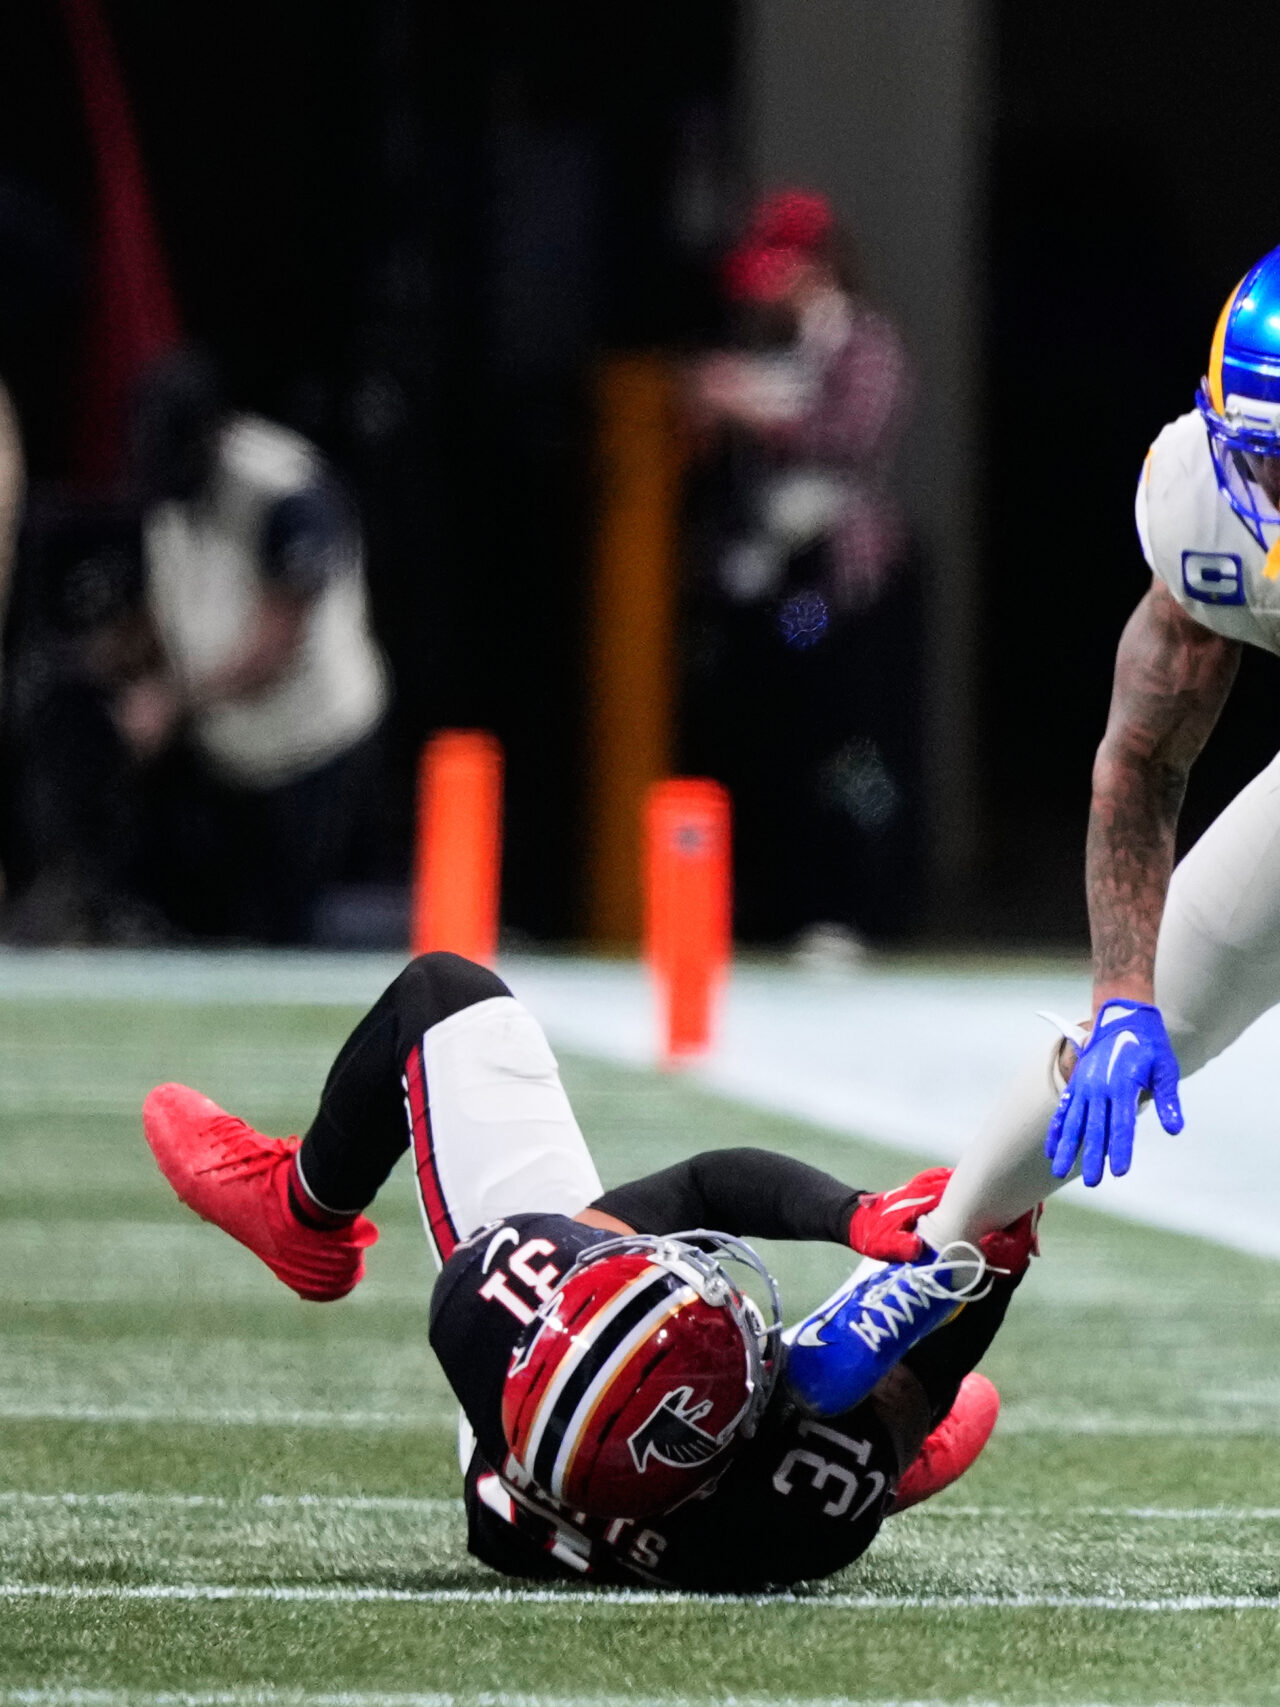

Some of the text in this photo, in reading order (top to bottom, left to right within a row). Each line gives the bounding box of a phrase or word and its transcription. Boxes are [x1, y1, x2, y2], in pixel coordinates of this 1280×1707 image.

[1186, 549, 1238, 594] C
[478, 1238, 561, 1326] 31
[773, 1419, 872, 1517] 31
